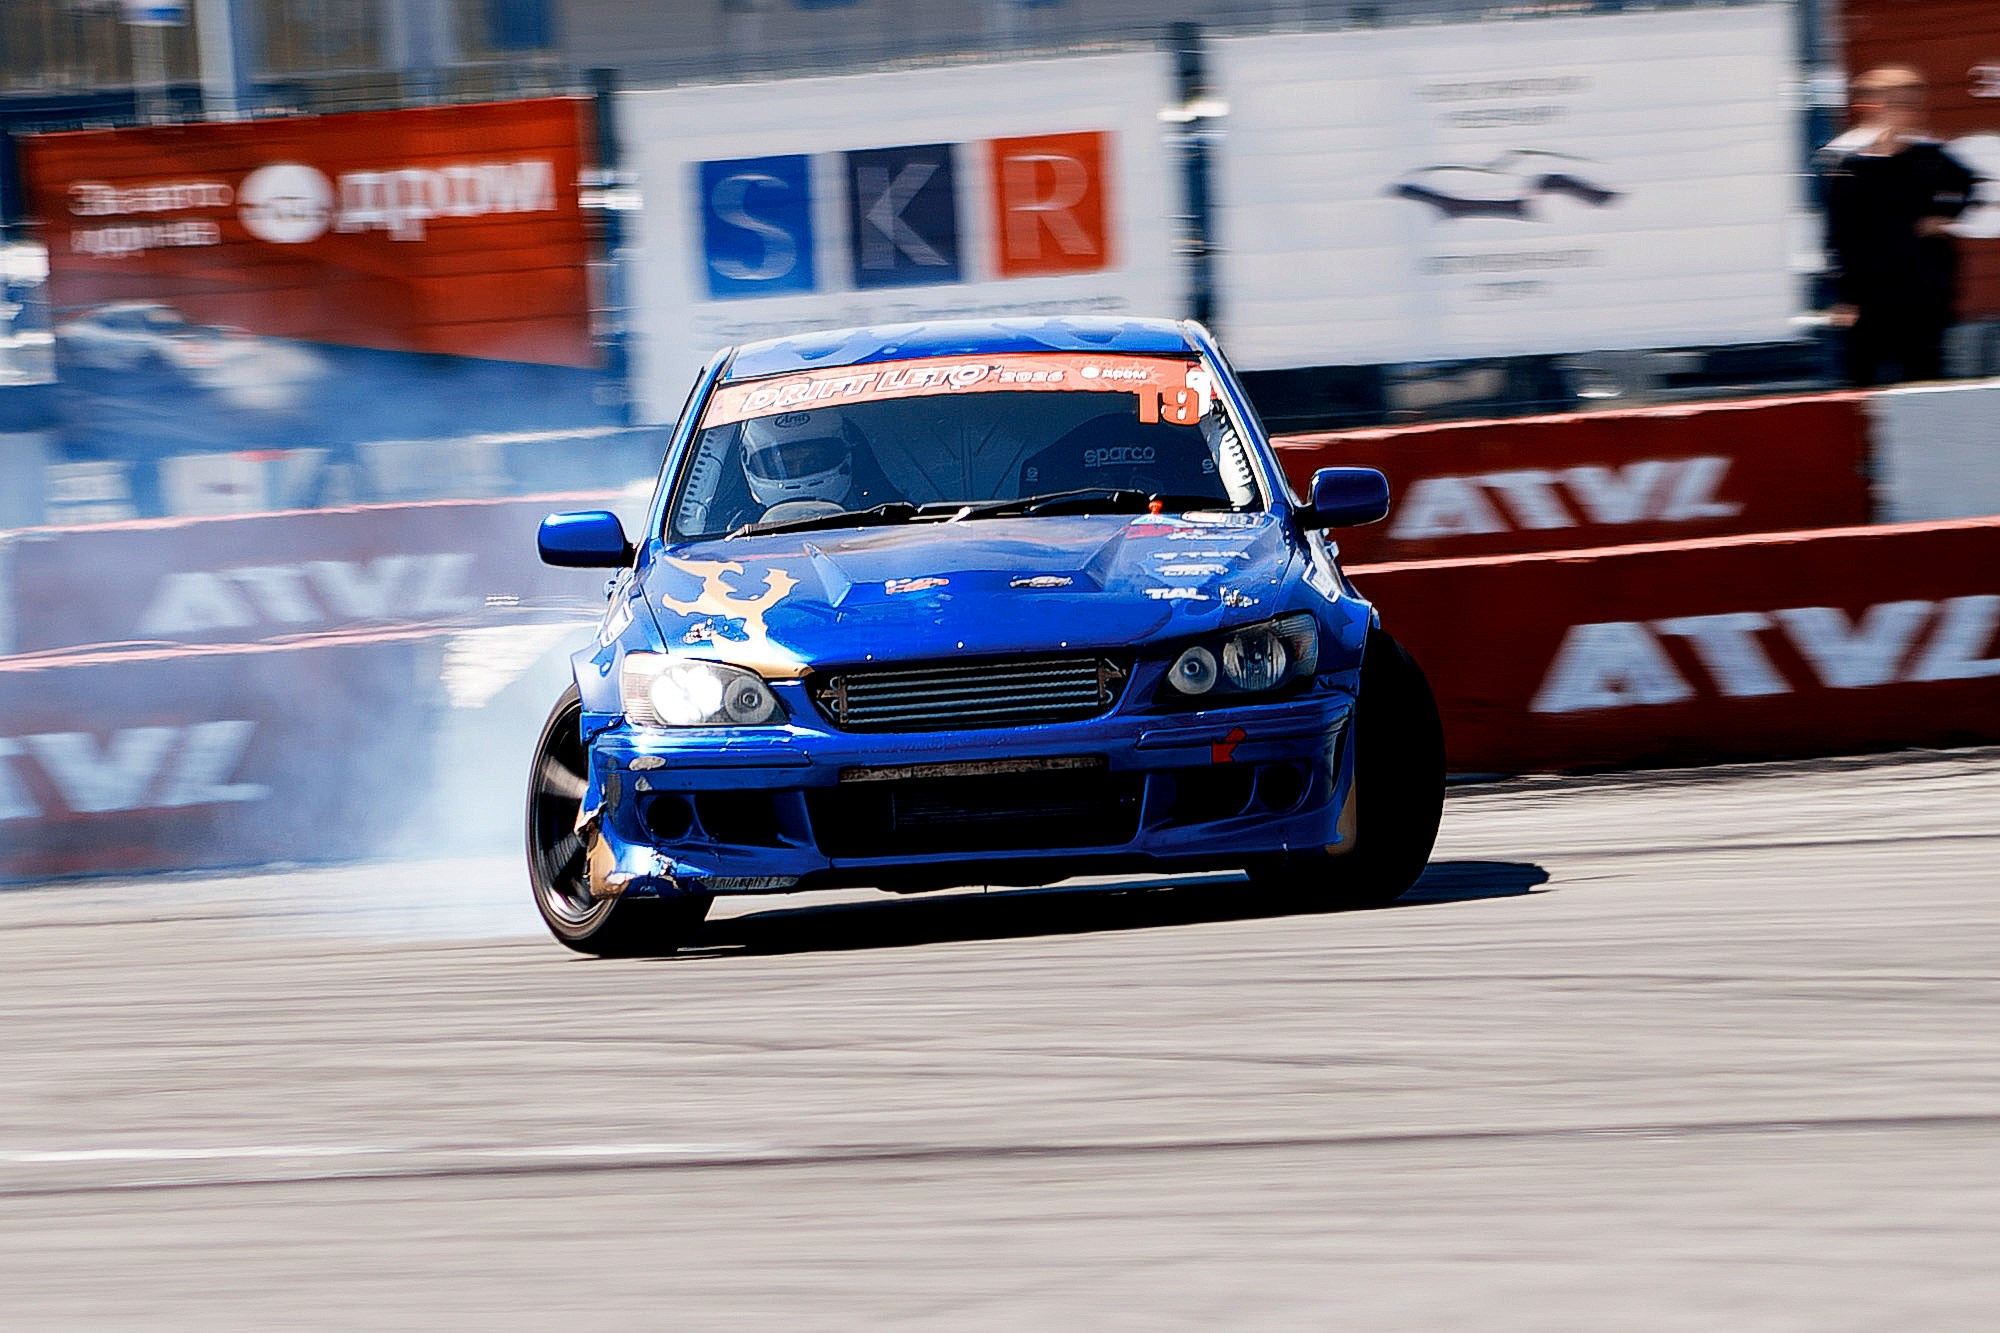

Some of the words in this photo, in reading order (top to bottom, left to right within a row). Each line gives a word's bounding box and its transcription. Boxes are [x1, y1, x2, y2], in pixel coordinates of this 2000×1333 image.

[709, 153, 1097, 284] SKR
[741, 373, 877, 413] DRIFT
[876, 362, 989, 392] LETO
[1133, 384, 1202, 426] 19
[1084, 446, 1155, 468] sparco
